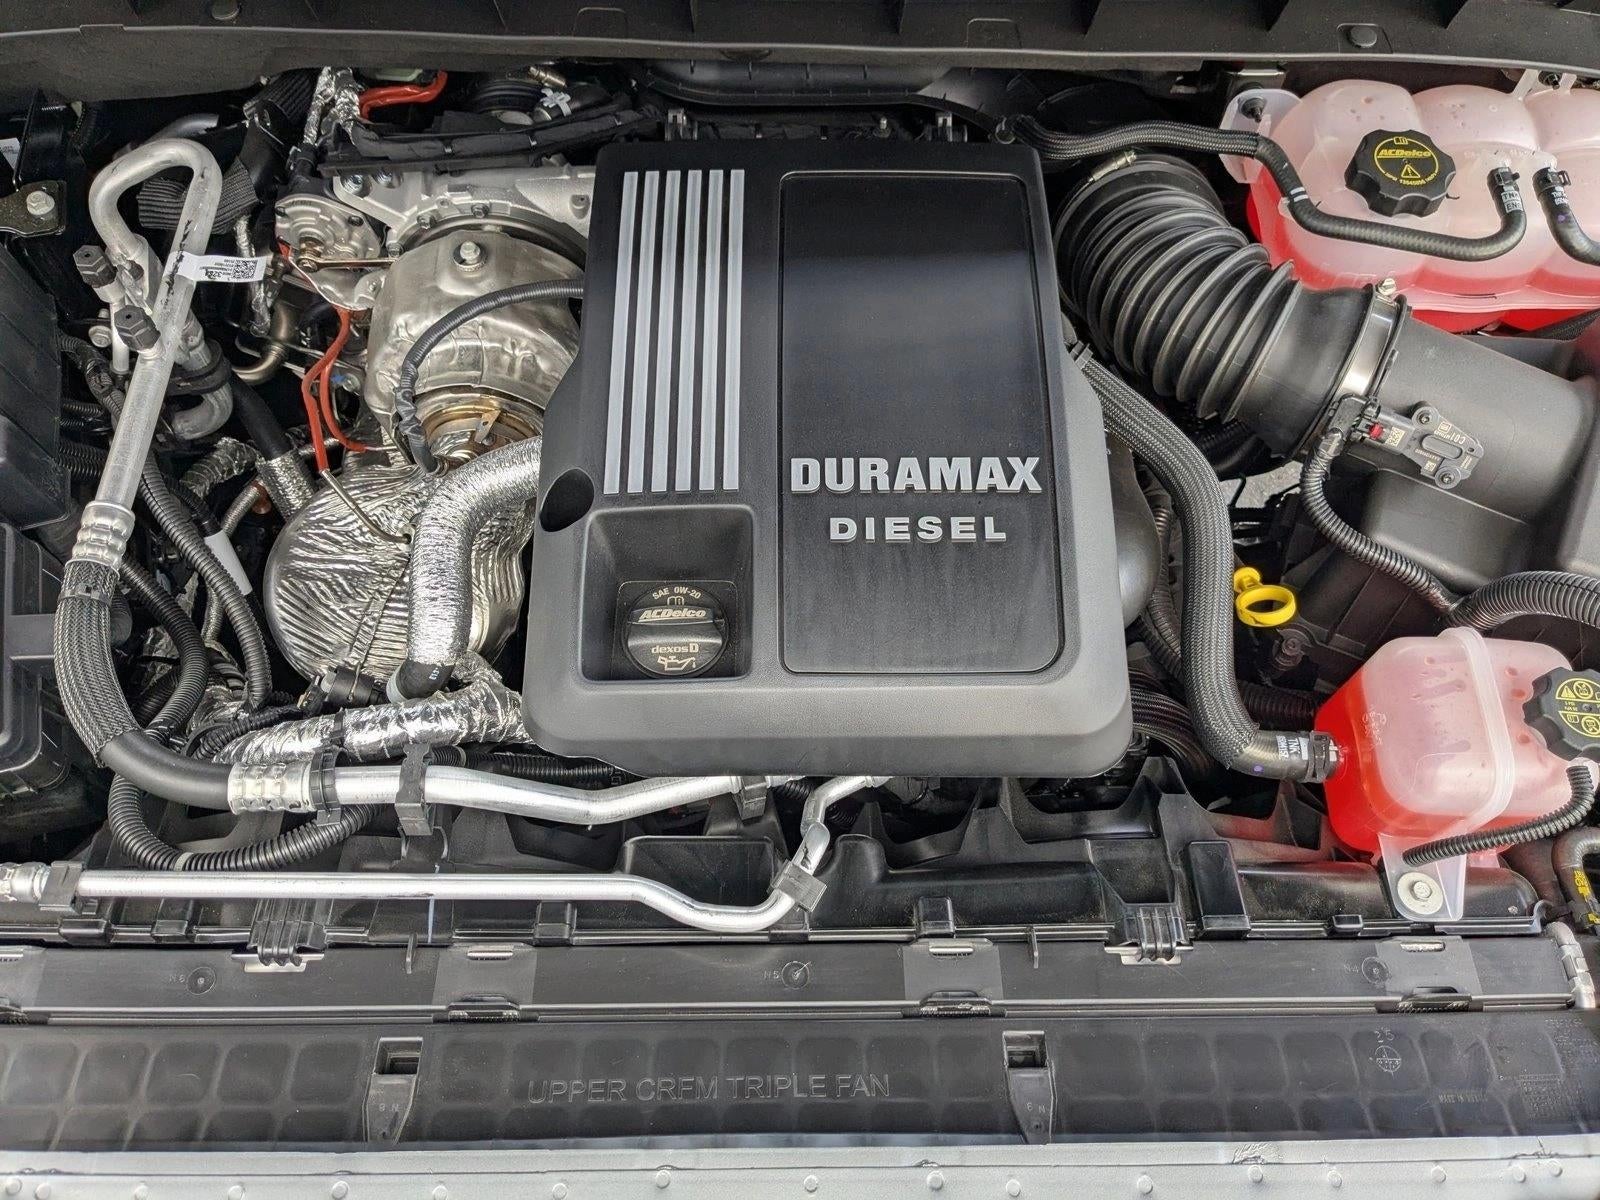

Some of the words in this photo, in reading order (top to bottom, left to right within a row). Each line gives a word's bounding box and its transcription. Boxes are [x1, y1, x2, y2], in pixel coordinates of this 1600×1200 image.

[1378, 149, 1431, 157] ACDelco
[791, 456, 1042, 493] DURAMAX
[829, 516, 1006, 543] DIESEL
[652, 587, 670, 600] SAE
[673, 586, 701, 599] 0W-20
[638, 608, 707, 620] ACDelco
[527, 1079, 627, 1103] UPPER
[635, 1077, 719, 1101] CRFM
[726, 1074, 827, 1099] TRIPLE
[836, 1073, 890, 1098] FAN
